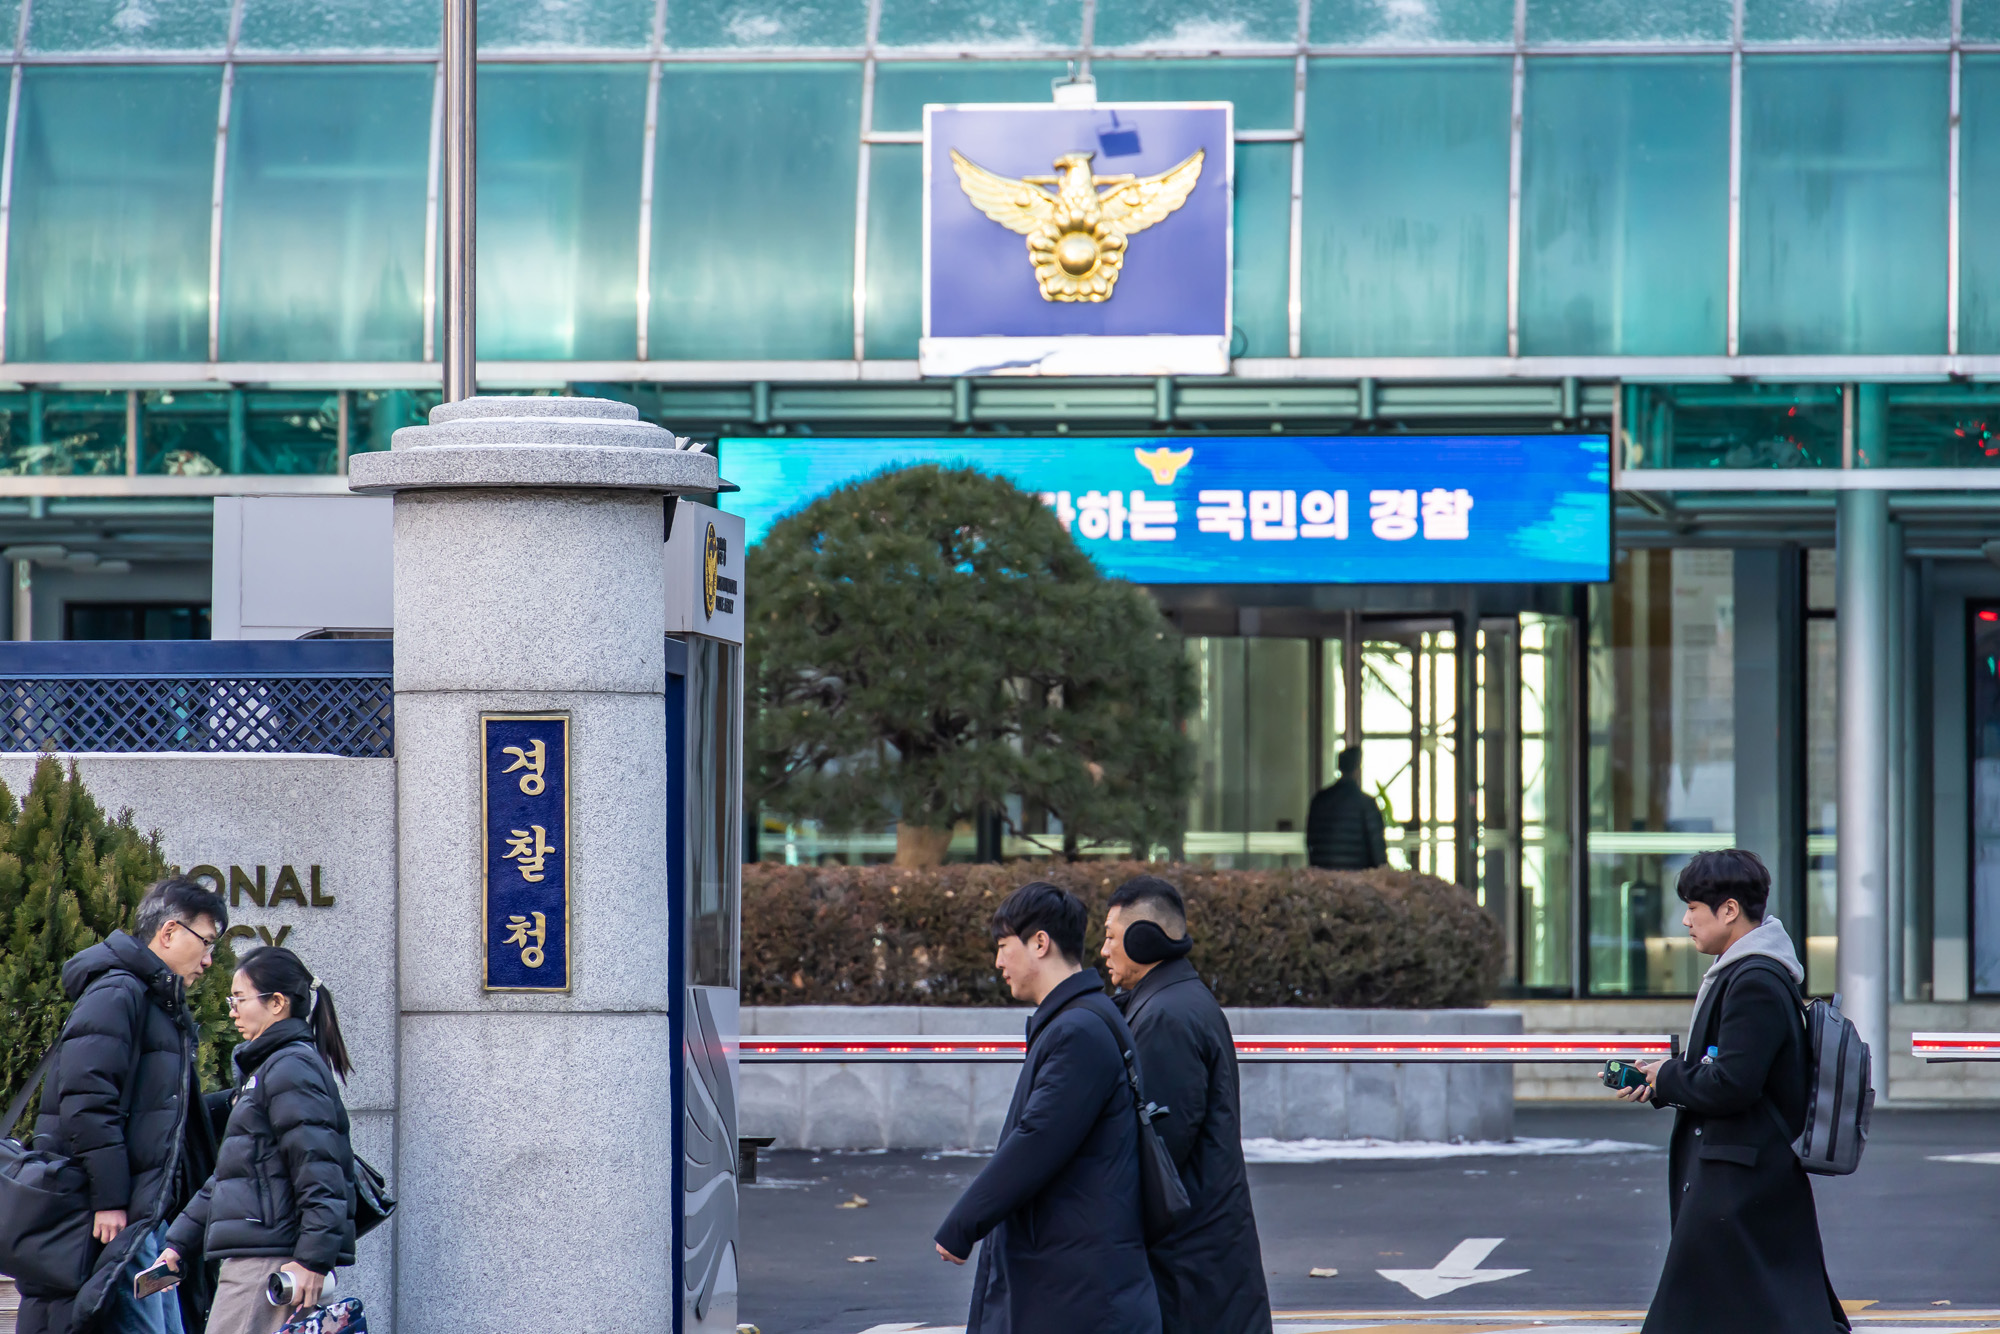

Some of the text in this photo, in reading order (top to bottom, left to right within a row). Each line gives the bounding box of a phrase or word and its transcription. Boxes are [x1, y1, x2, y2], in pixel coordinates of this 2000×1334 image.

[1196, 489, 1349, 541] 국민의
[1369, 488, 1473, 541] 경찰
[502, 739, 555, 968] 경찰청
[170, 864, 334, 907] ONAL
